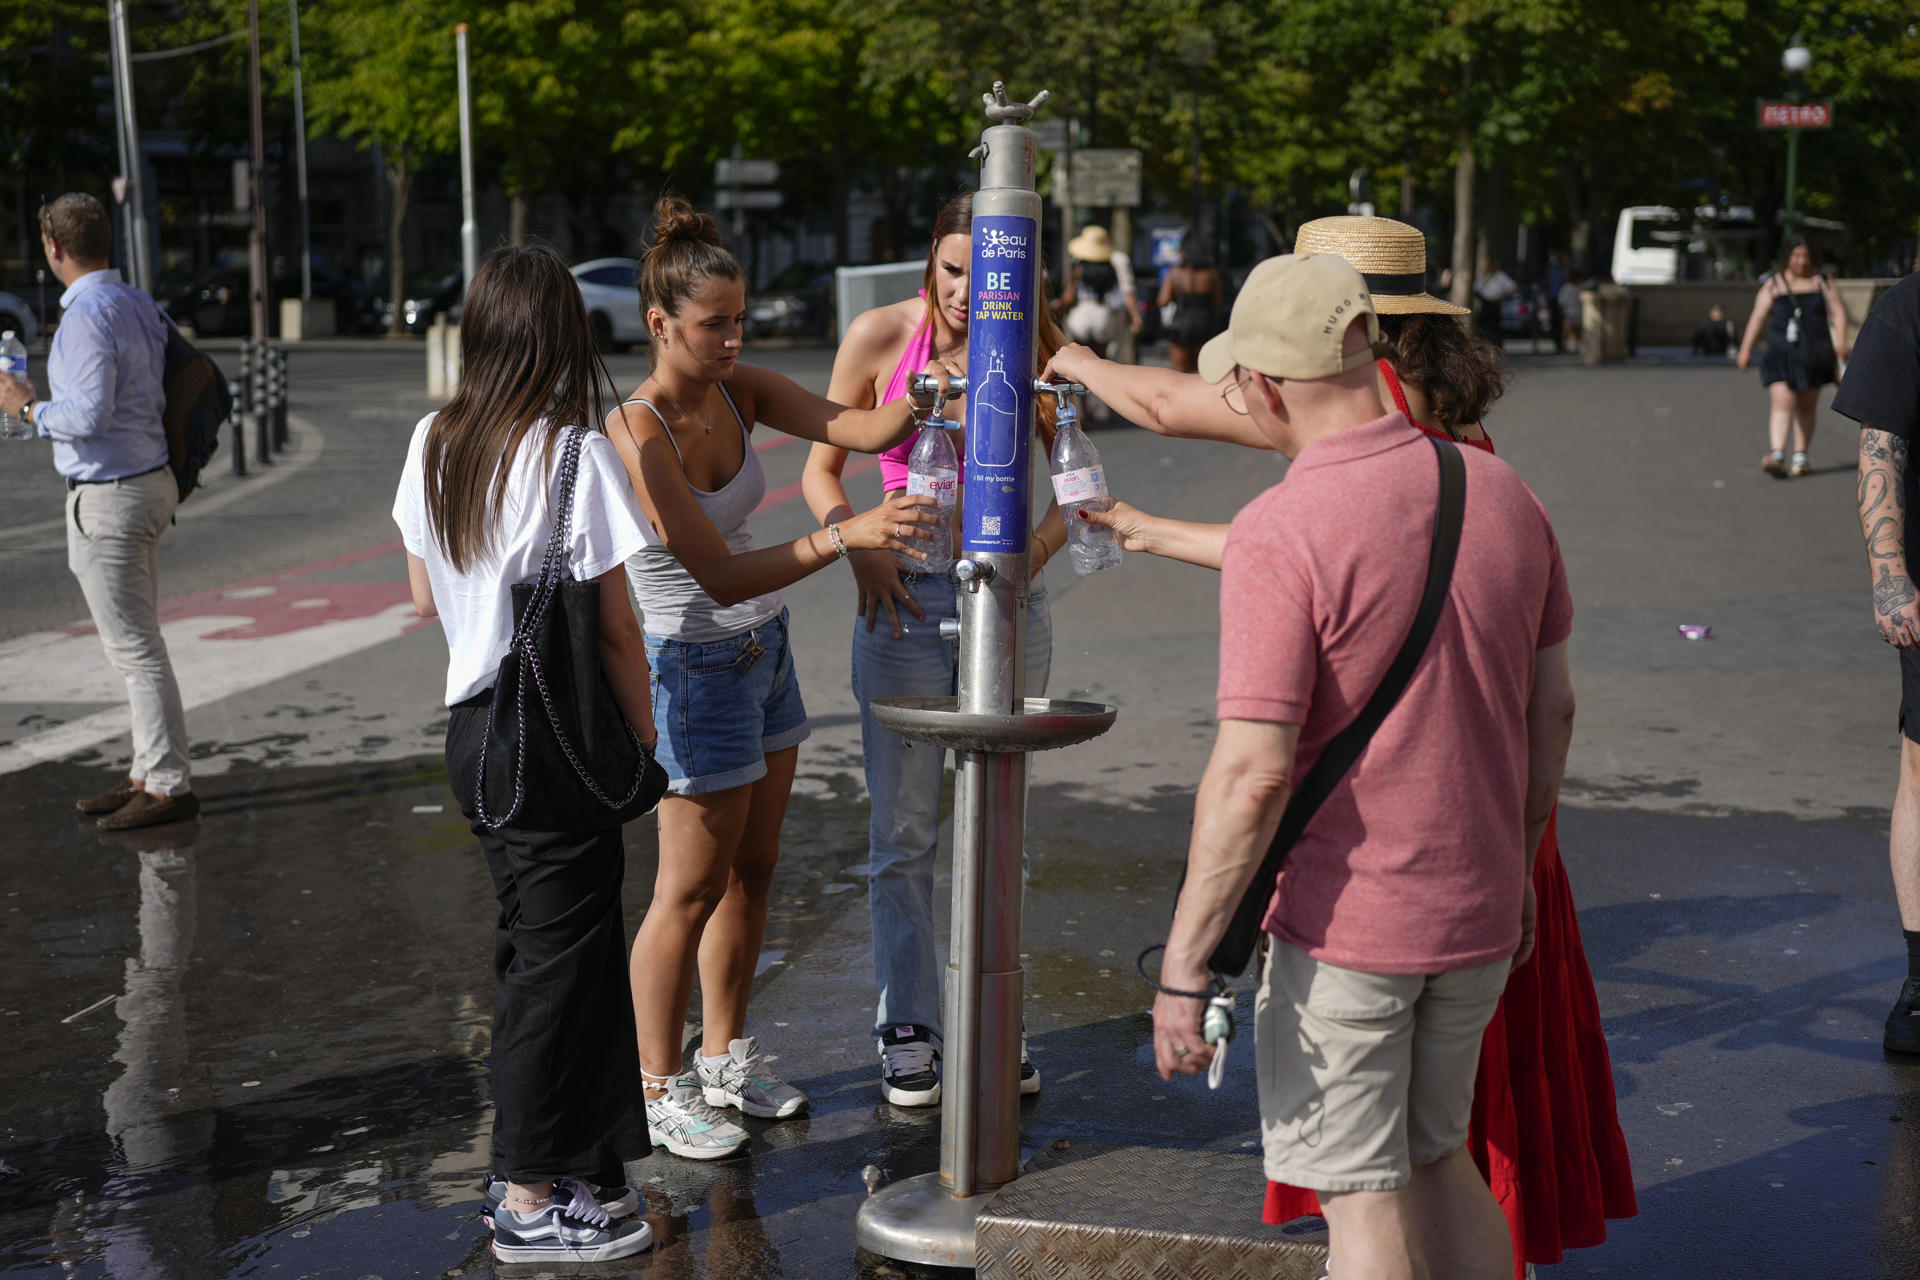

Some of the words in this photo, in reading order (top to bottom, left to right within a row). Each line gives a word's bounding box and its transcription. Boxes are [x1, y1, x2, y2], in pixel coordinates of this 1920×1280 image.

[1000, 234, 1027, 246] eau
[981, 248, 995, 258] de
[997, 247, 1026, 259] Paris
[986, 271, 1012, 290] BE
[975, 311, 990, 320] TAP
[991, 311, 1024, 321] WATER
[1323, 299, 1352, 335] HUGO
[930, 480, 956, 490] evian
